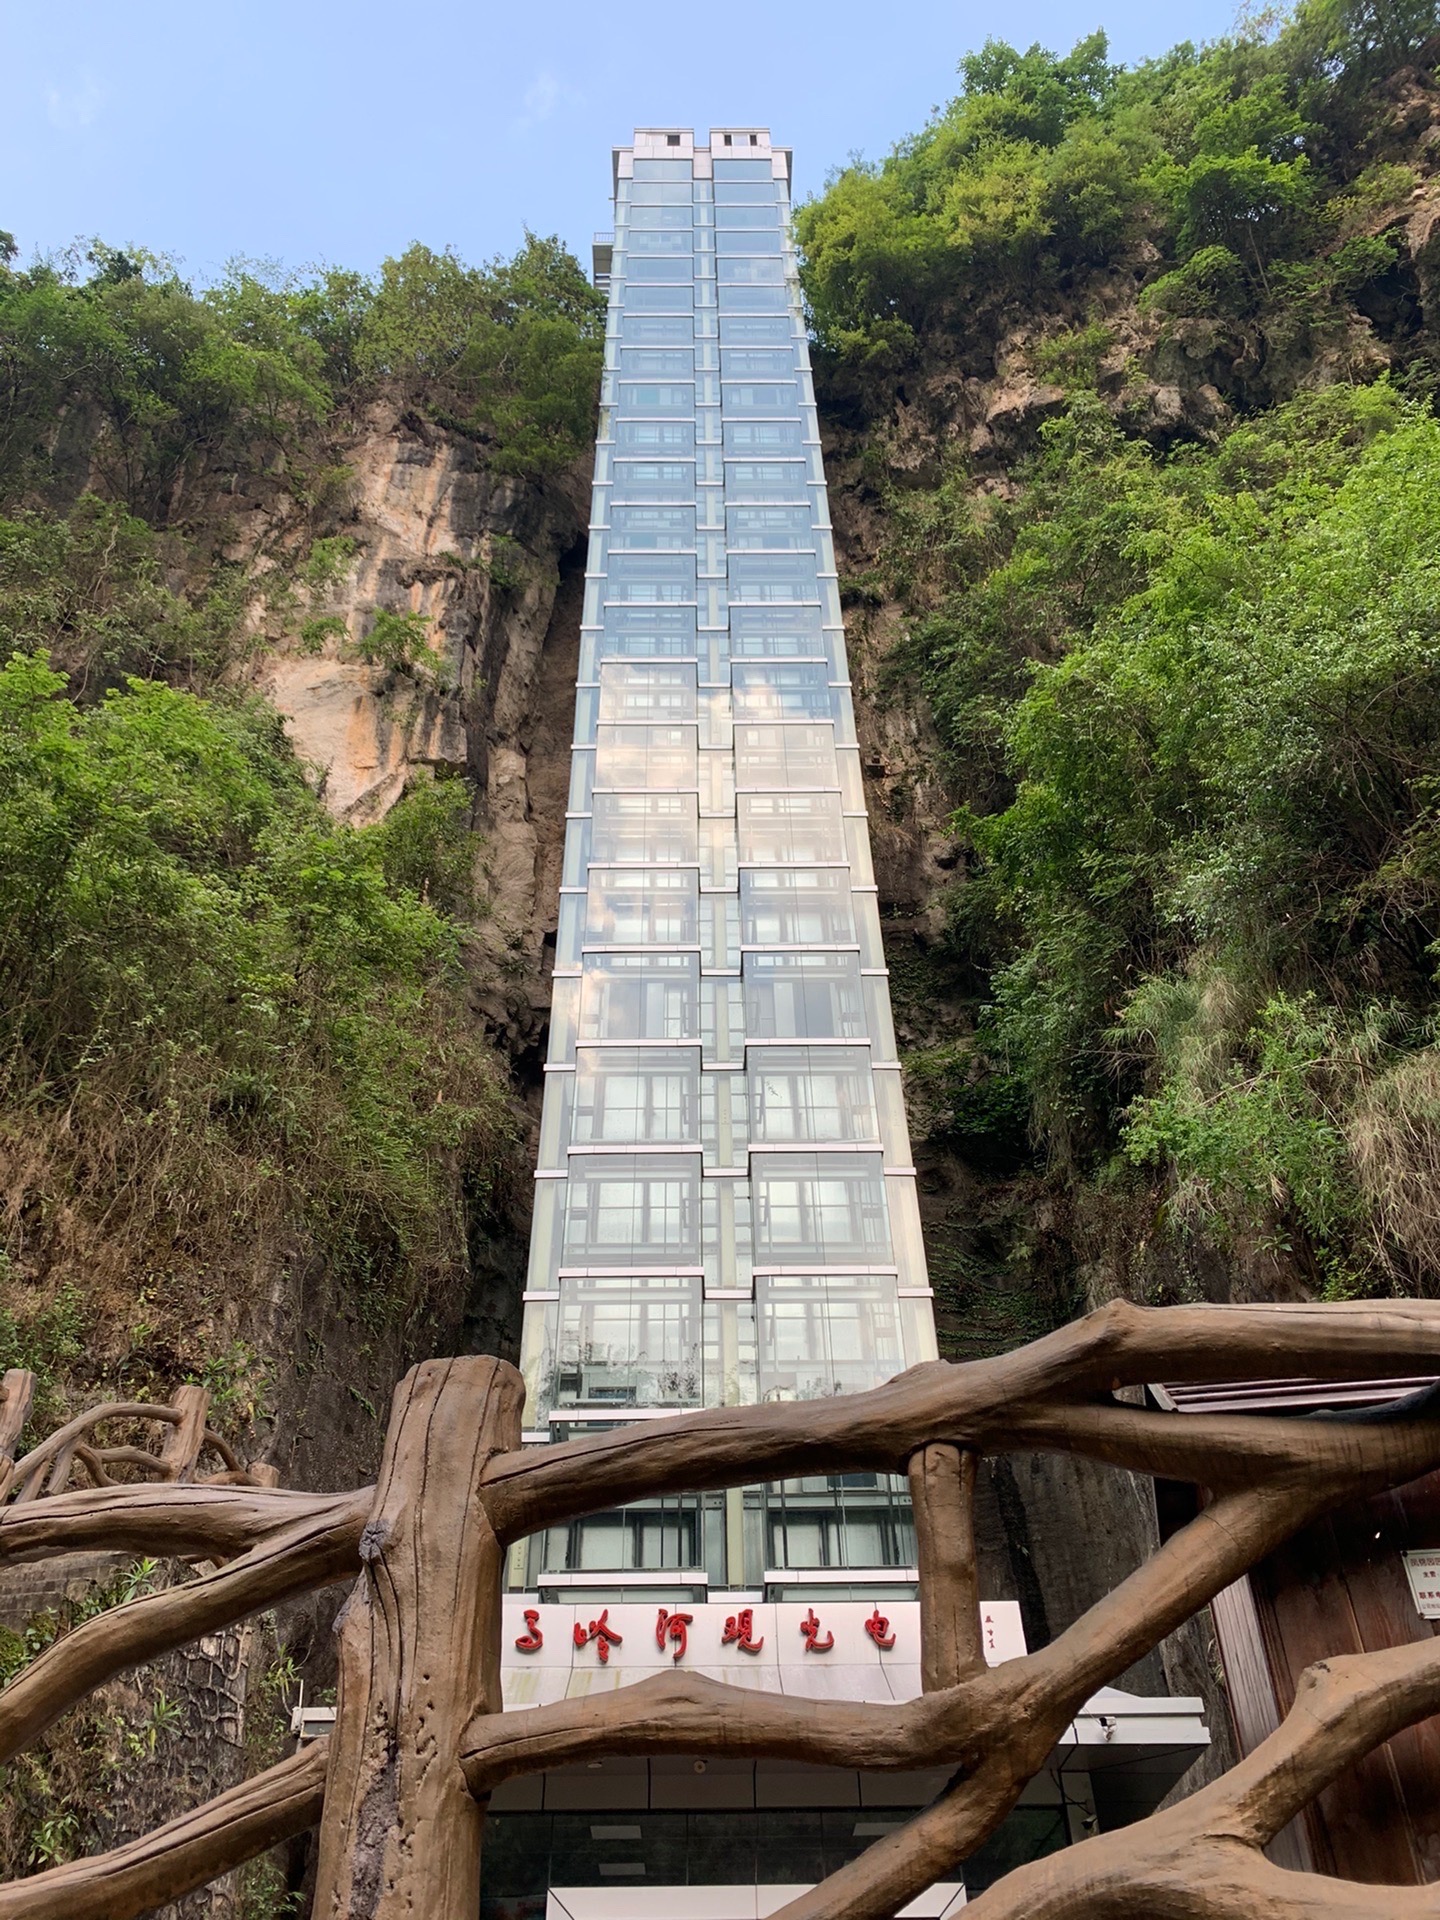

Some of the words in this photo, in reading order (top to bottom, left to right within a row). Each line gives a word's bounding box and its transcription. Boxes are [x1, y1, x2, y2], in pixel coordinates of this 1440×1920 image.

[515, 1608, 896, 1663] 马岭河观光电
